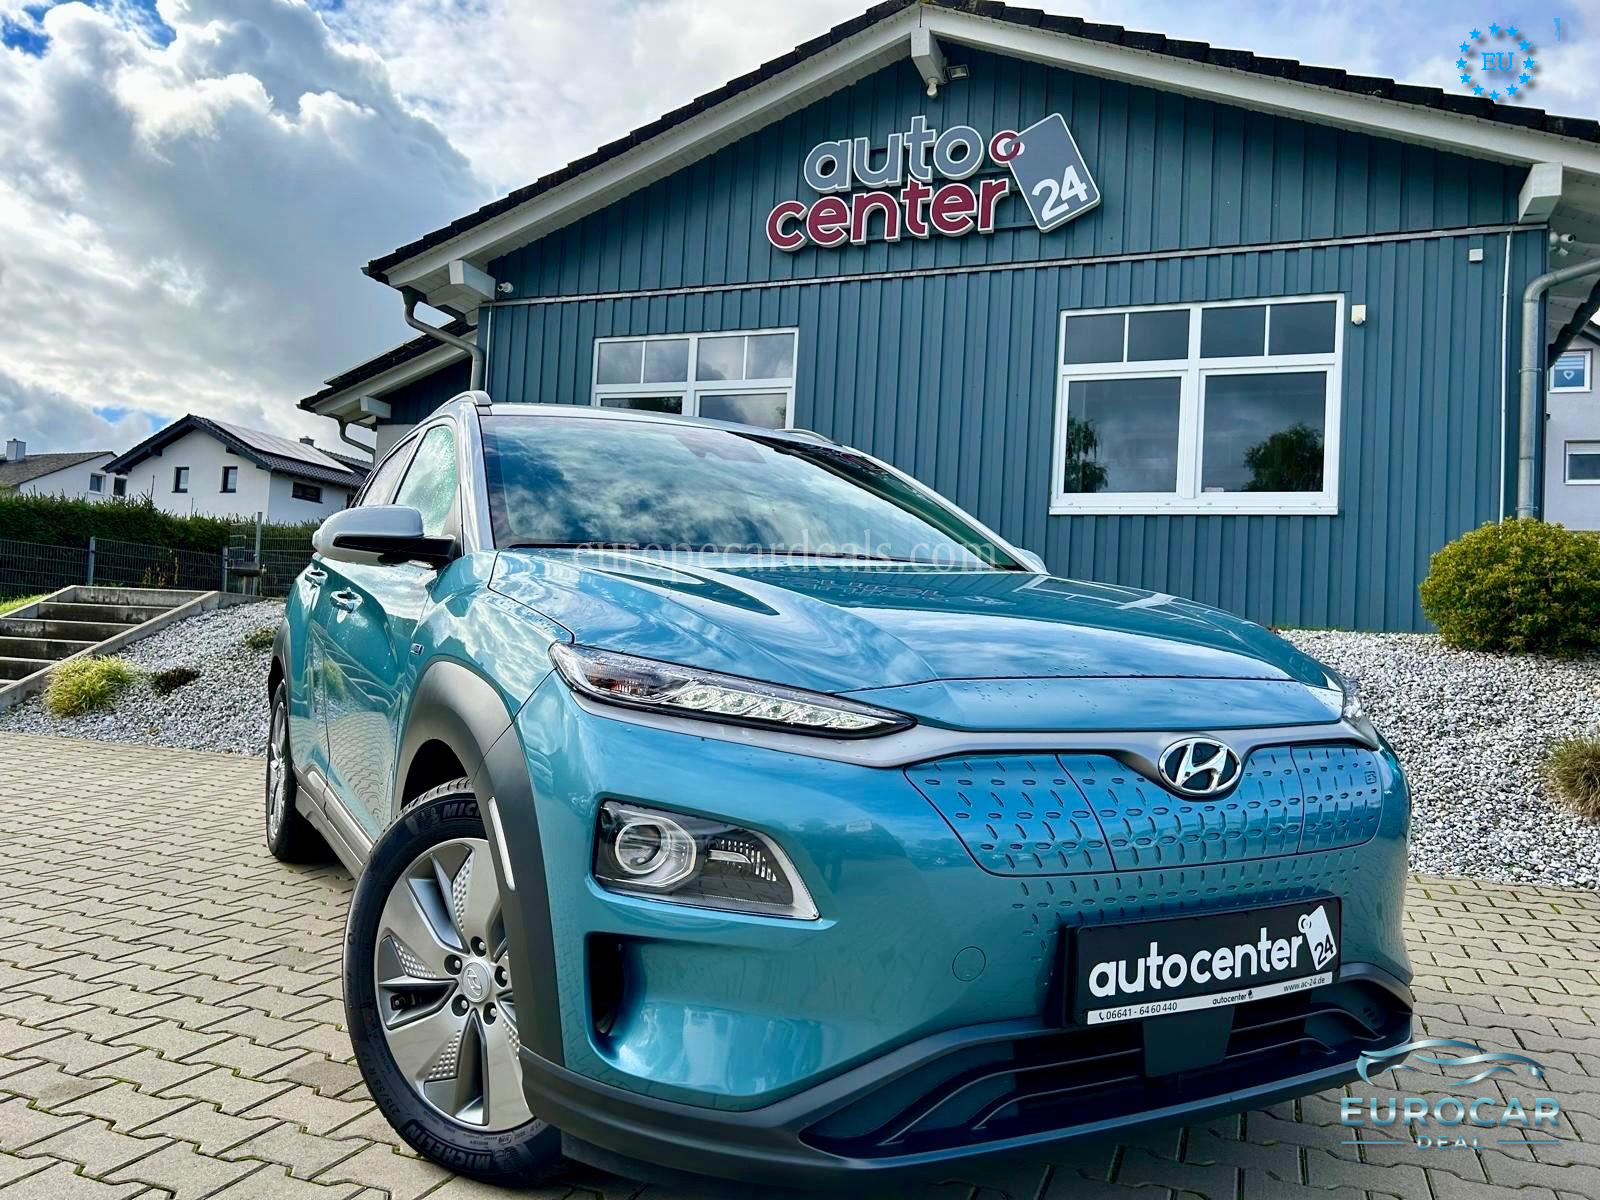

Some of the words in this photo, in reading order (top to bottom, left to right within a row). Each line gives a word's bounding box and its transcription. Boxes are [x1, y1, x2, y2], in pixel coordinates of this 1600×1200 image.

[804, 115, 984, 194] auto
[766, 174, 1010, 252] center
[1031, 165, 1088, 222] 24
[1314, 934, 1335, 965] 24
[1212, 993, 1247, 1005] autocenter
[405, 1123, 491, 1170] MICHELIN
